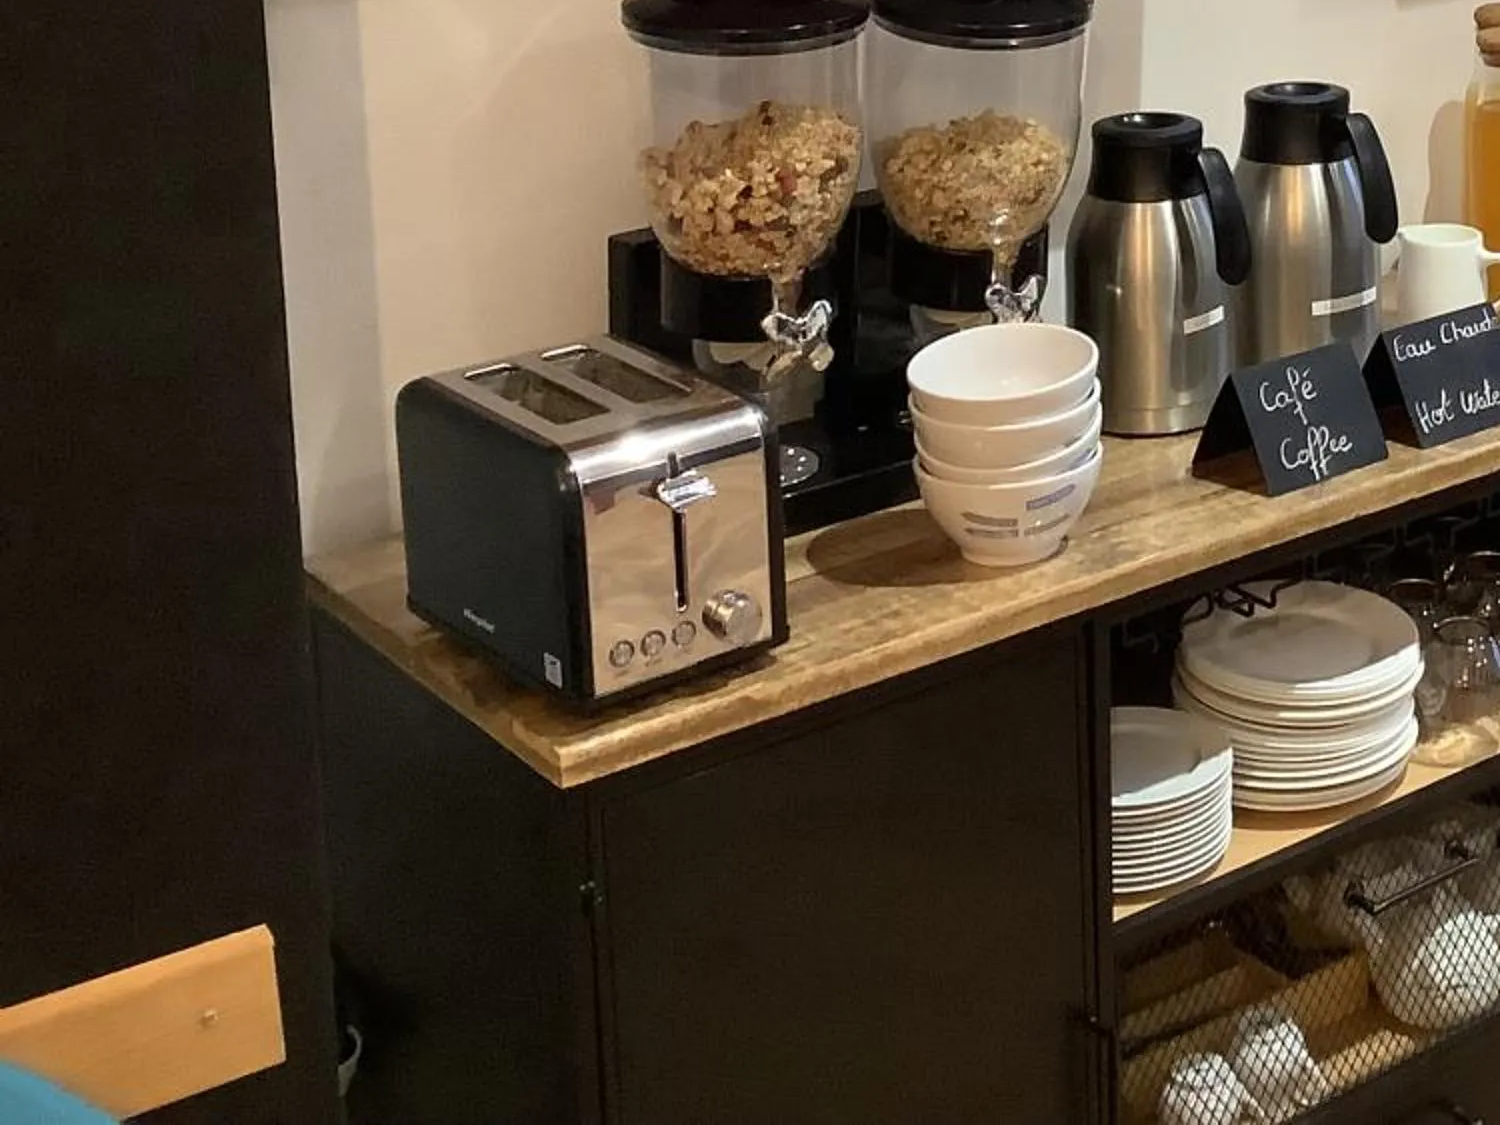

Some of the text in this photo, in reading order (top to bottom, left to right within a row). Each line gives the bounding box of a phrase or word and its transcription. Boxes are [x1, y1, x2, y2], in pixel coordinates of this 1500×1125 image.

[1393, 334, 1437, 362] Eau
[1259, 366, 1317, 425] Café
[1415, 388, 1455, 435] Hot
[1280, 426, 1353, 481] Coffee
